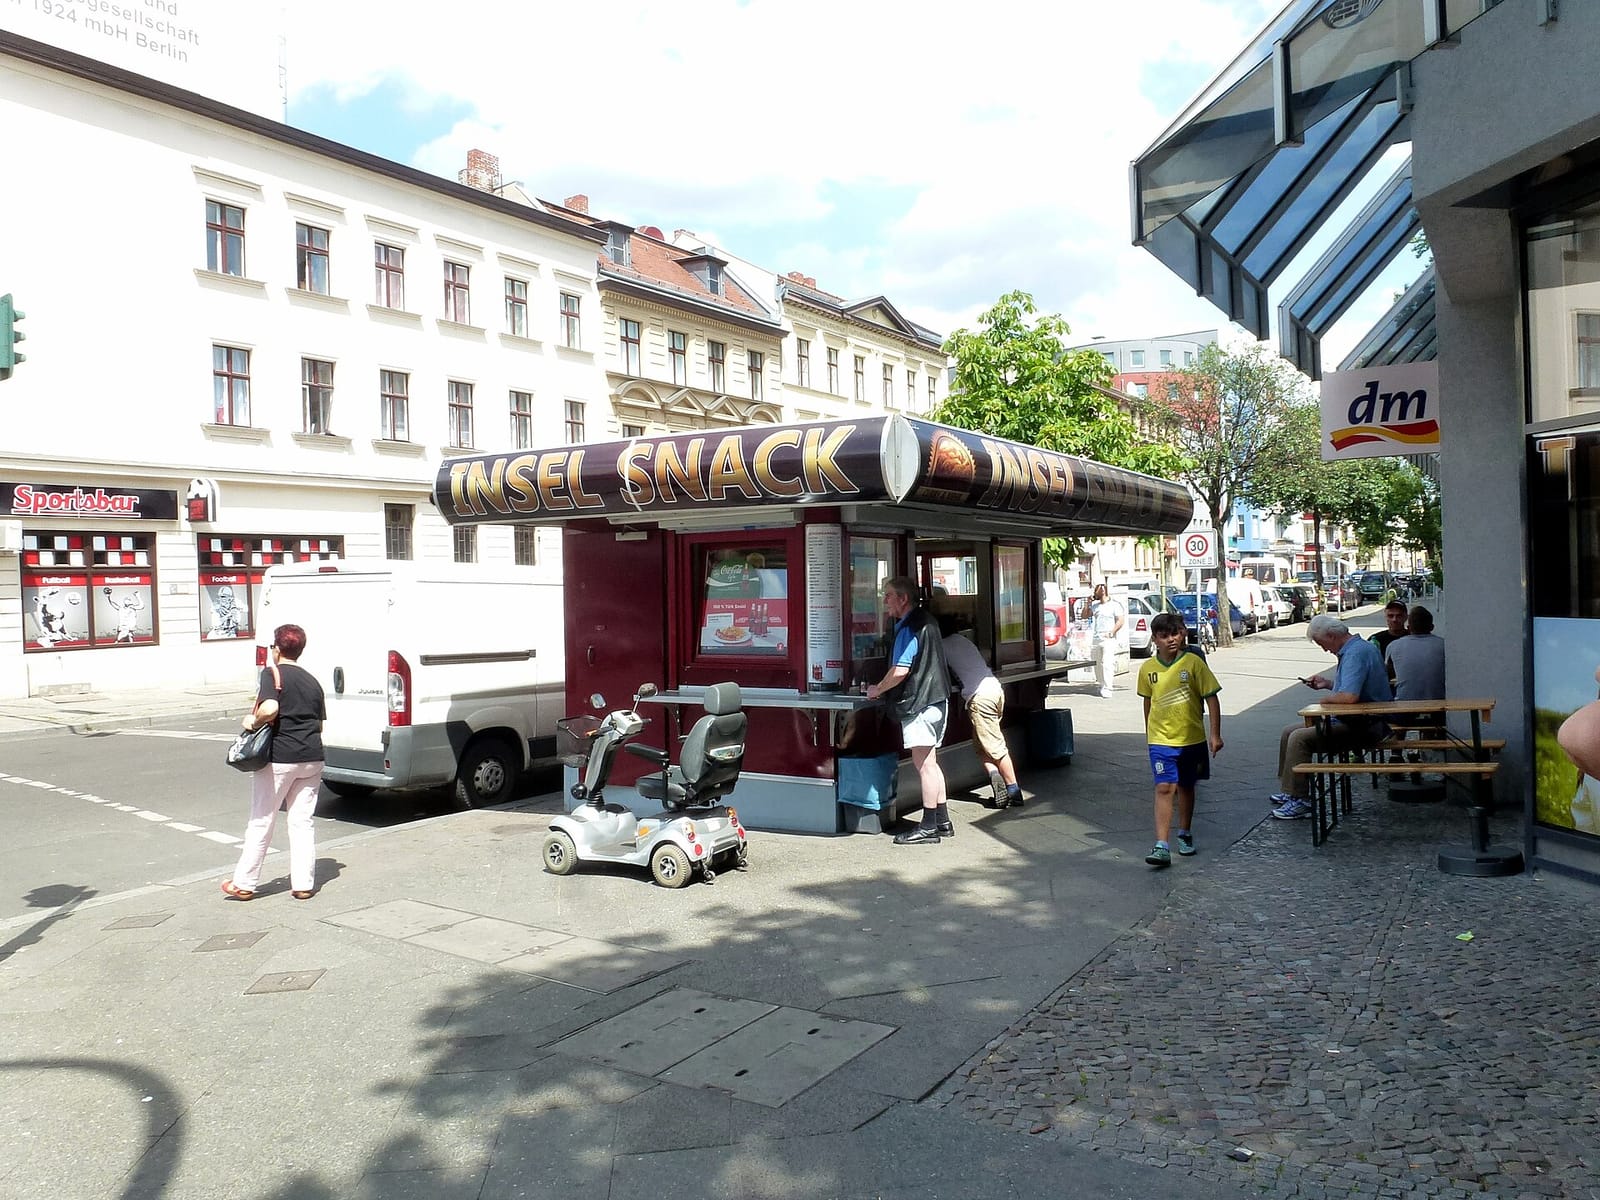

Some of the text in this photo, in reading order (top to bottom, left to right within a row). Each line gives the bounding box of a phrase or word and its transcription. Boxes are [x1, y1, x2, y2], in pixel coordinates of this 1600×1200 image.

[85, 16, 129, 42] mbH
[136, 32, 188, 63] Berlin
[1348, 380, 1427, 425] dm
[448, 425, 860, 517] INSEL SNACK
[976, 439, 1076, 517] INSEL
[13, 485, 140, 514] Sportsbar
[1190, 540, 1204, 552] 30
[211, 575, 237, 583] Football
[1148, 672, 1158, 684] 10
